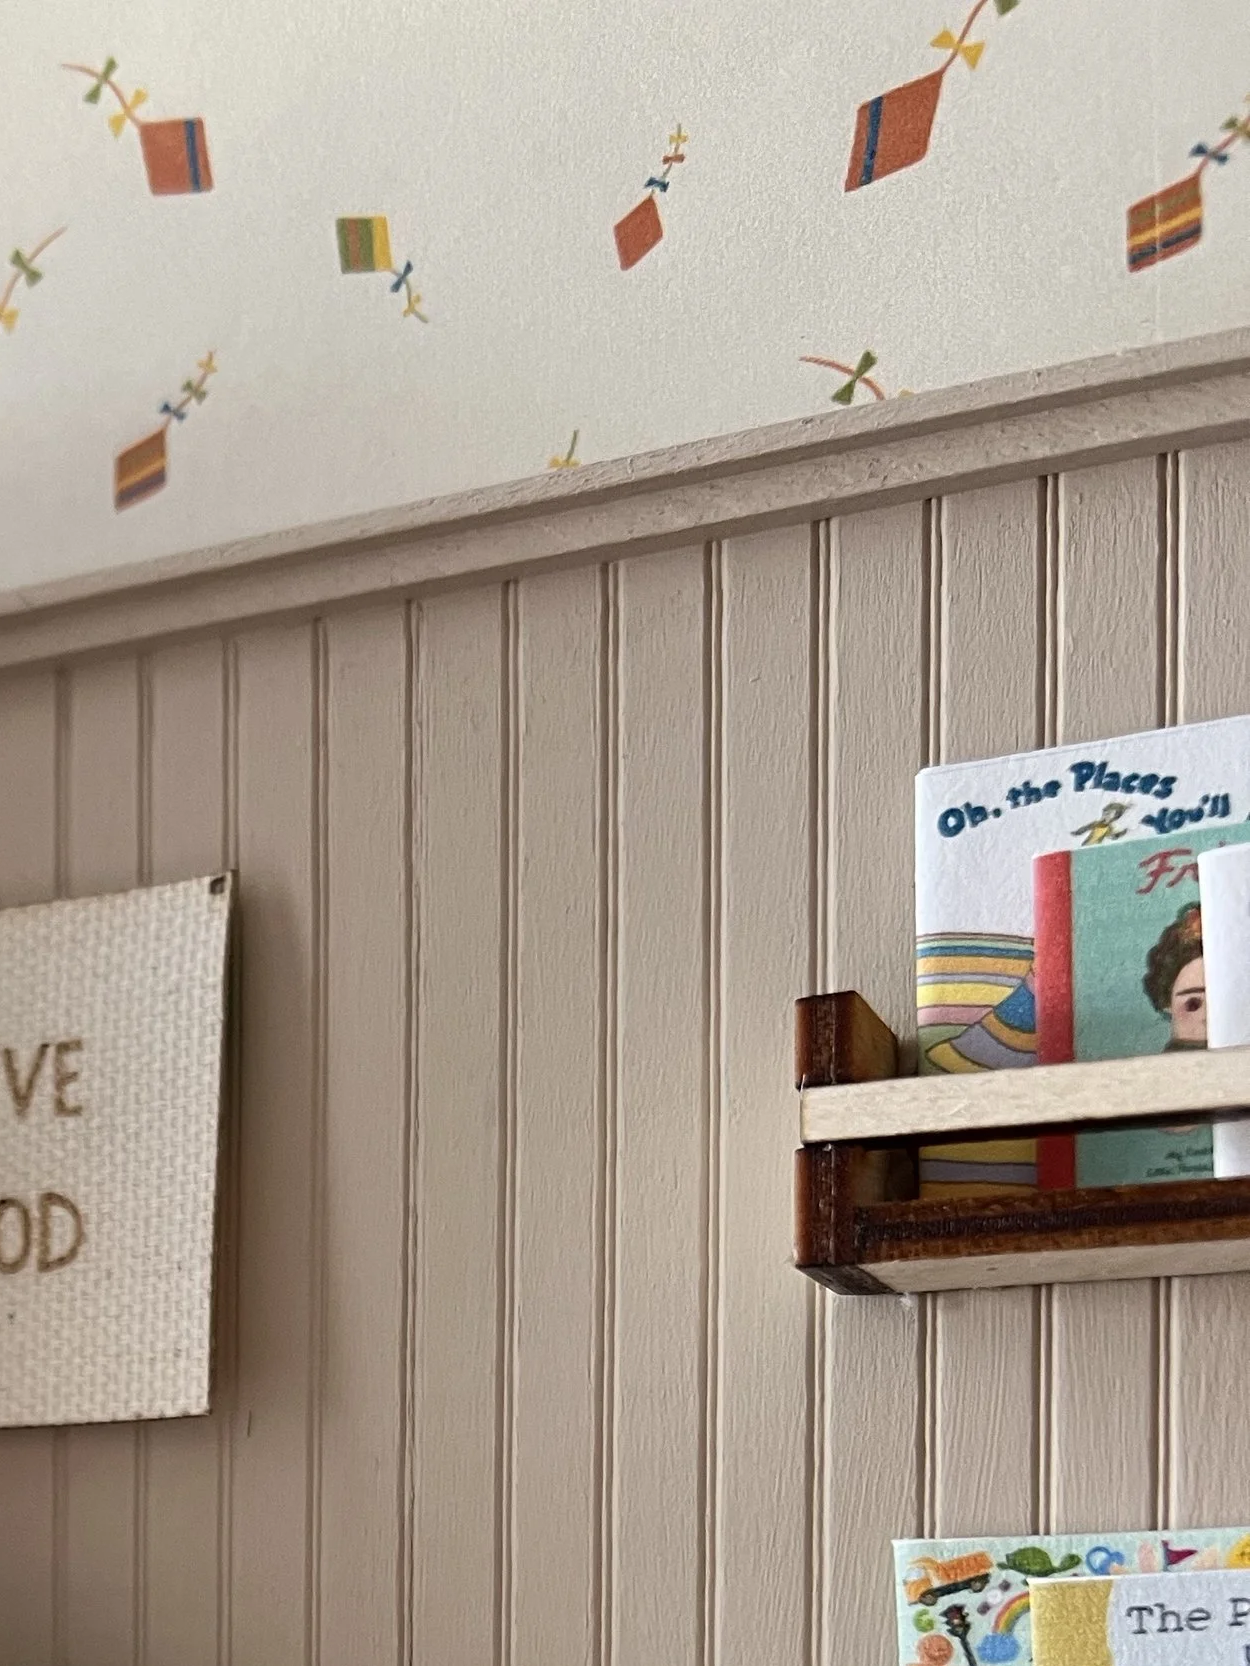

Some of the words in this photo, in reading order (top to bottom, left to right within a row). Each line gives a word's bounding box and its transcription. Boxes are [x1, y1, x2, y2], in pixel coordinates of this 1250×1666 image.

[1005, 779, 1063, 809] the
[1069, 760, 1177, 800] Places
[1141, 793, 1231, 834] You'll
[1125, 1602, 1212, 1635] The
